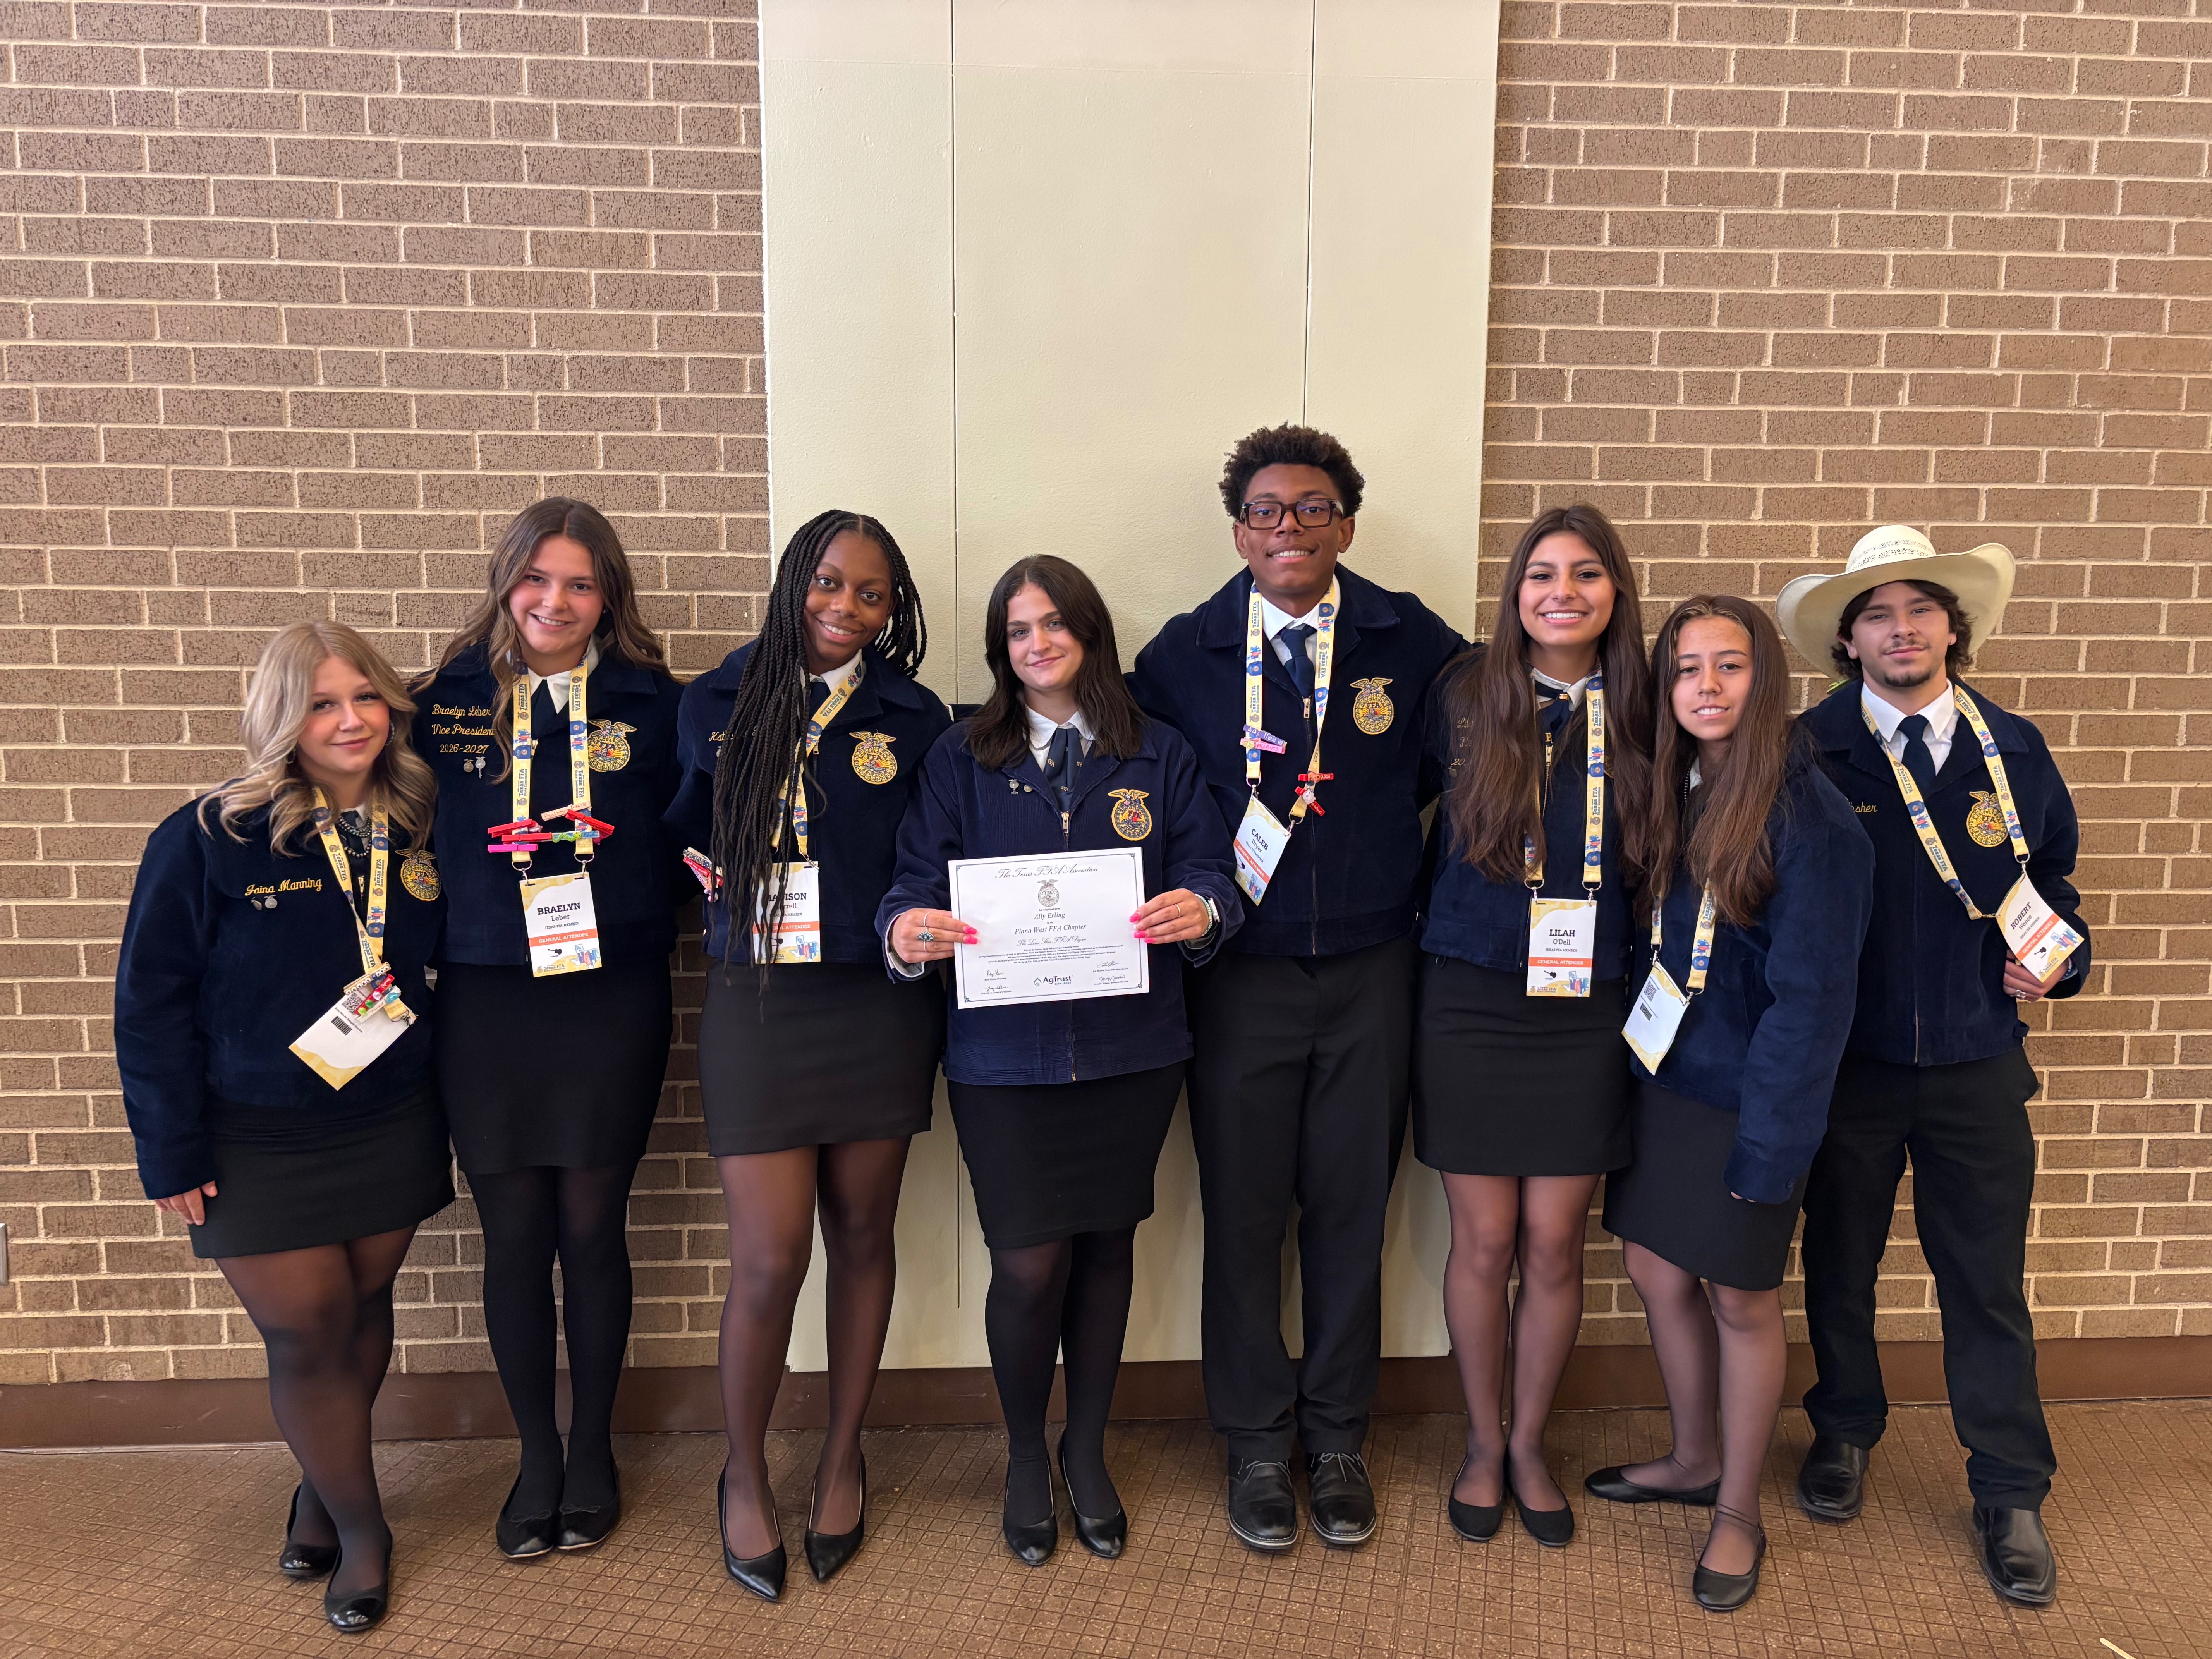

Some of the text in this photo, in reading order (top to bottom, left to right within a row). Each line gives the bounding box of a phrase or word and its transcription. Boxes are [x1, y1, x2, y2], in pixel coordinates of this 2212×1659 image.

[432, 704, 466, 719] Braelyn
[823, 708, 832, 717] FFA
[431, 724, 495, 736] Vice President
[1252, 829, 1268, 850] CALEB
[1252, 839, 1262, 852] Dryer
[1238, 845, 1250, 860] GENERAL
[995, 869, 1010, 878] The
[244, 878, 322, 896] Jaina Manning
[537, 902, 581, 915] BRAELYN
[2011, 902, 2032, 929] ROBERT
[2019, 915, 2032, 930] Wence
[2023, 920, 2053, 953] GENERAL ATTENDEE
[1043, 975, 1072, 984] AgTrust
